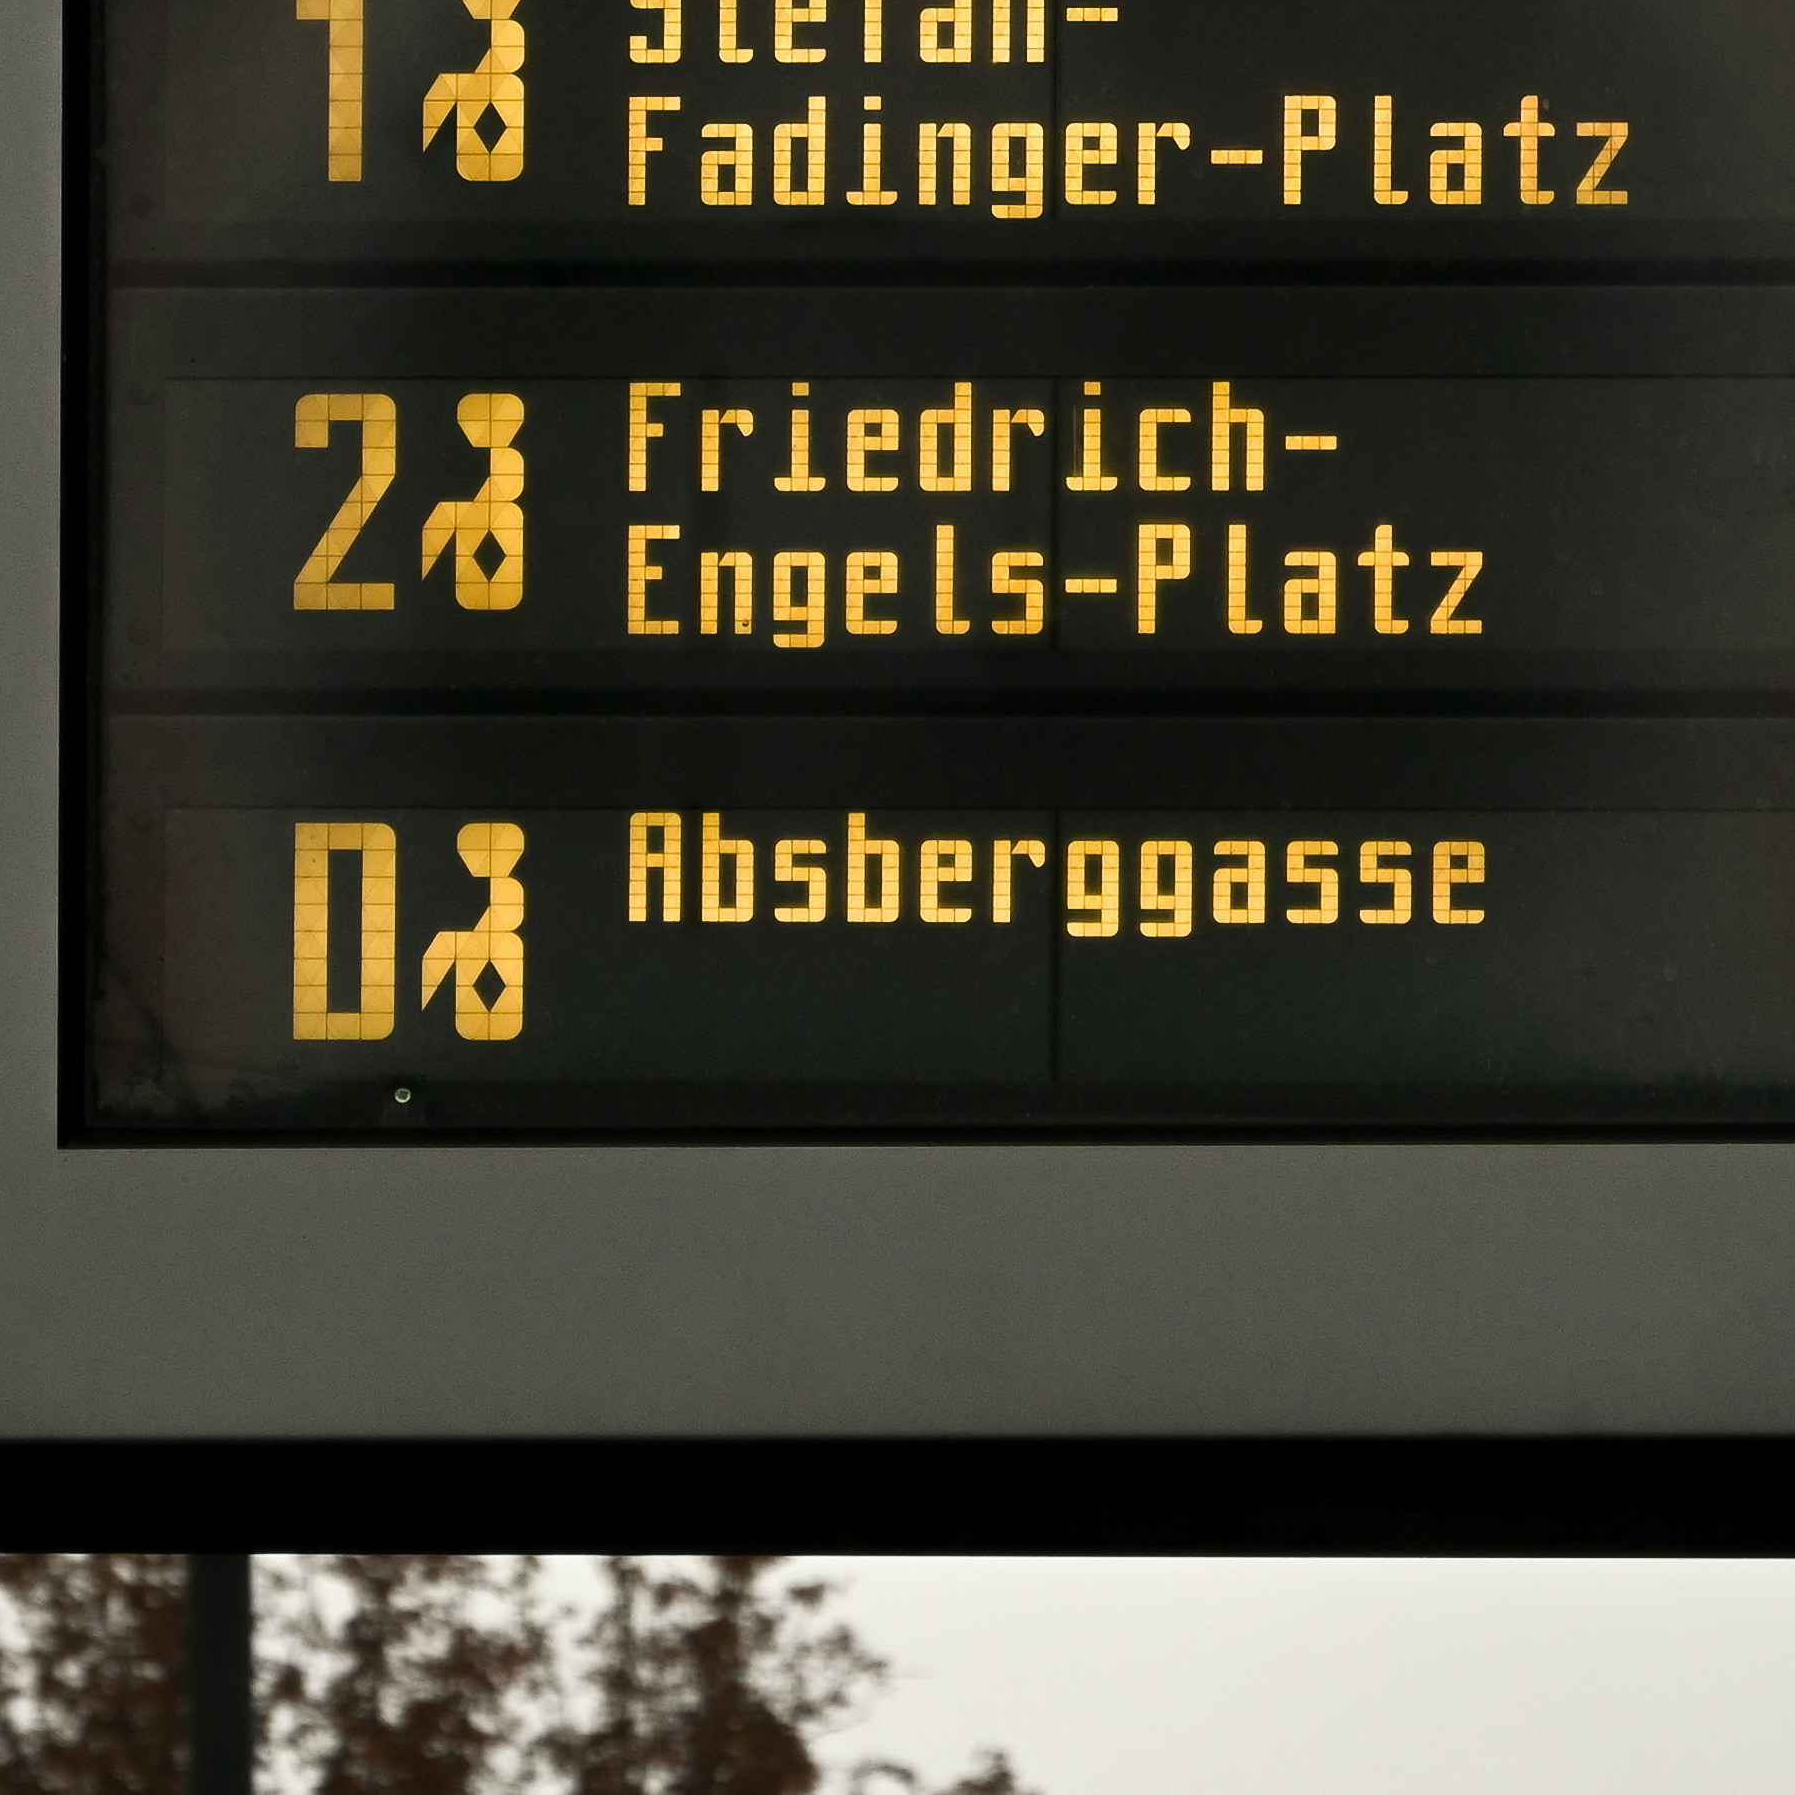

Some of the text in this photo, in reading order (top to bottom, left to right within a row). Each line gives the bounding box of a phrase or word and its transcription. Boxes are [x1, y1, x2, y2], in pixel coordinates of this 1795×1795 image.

[628, 95, 1629, 219] Fadinger-Platz
[627, 381, 1338, 492] Friedrich-
[293, 393, 397, 611] 2
[627, 523, 1484, 649] Engels-Platz
[292, 822, 397, 1041] D
[628, 811, 1486, 938] Absberggasse
